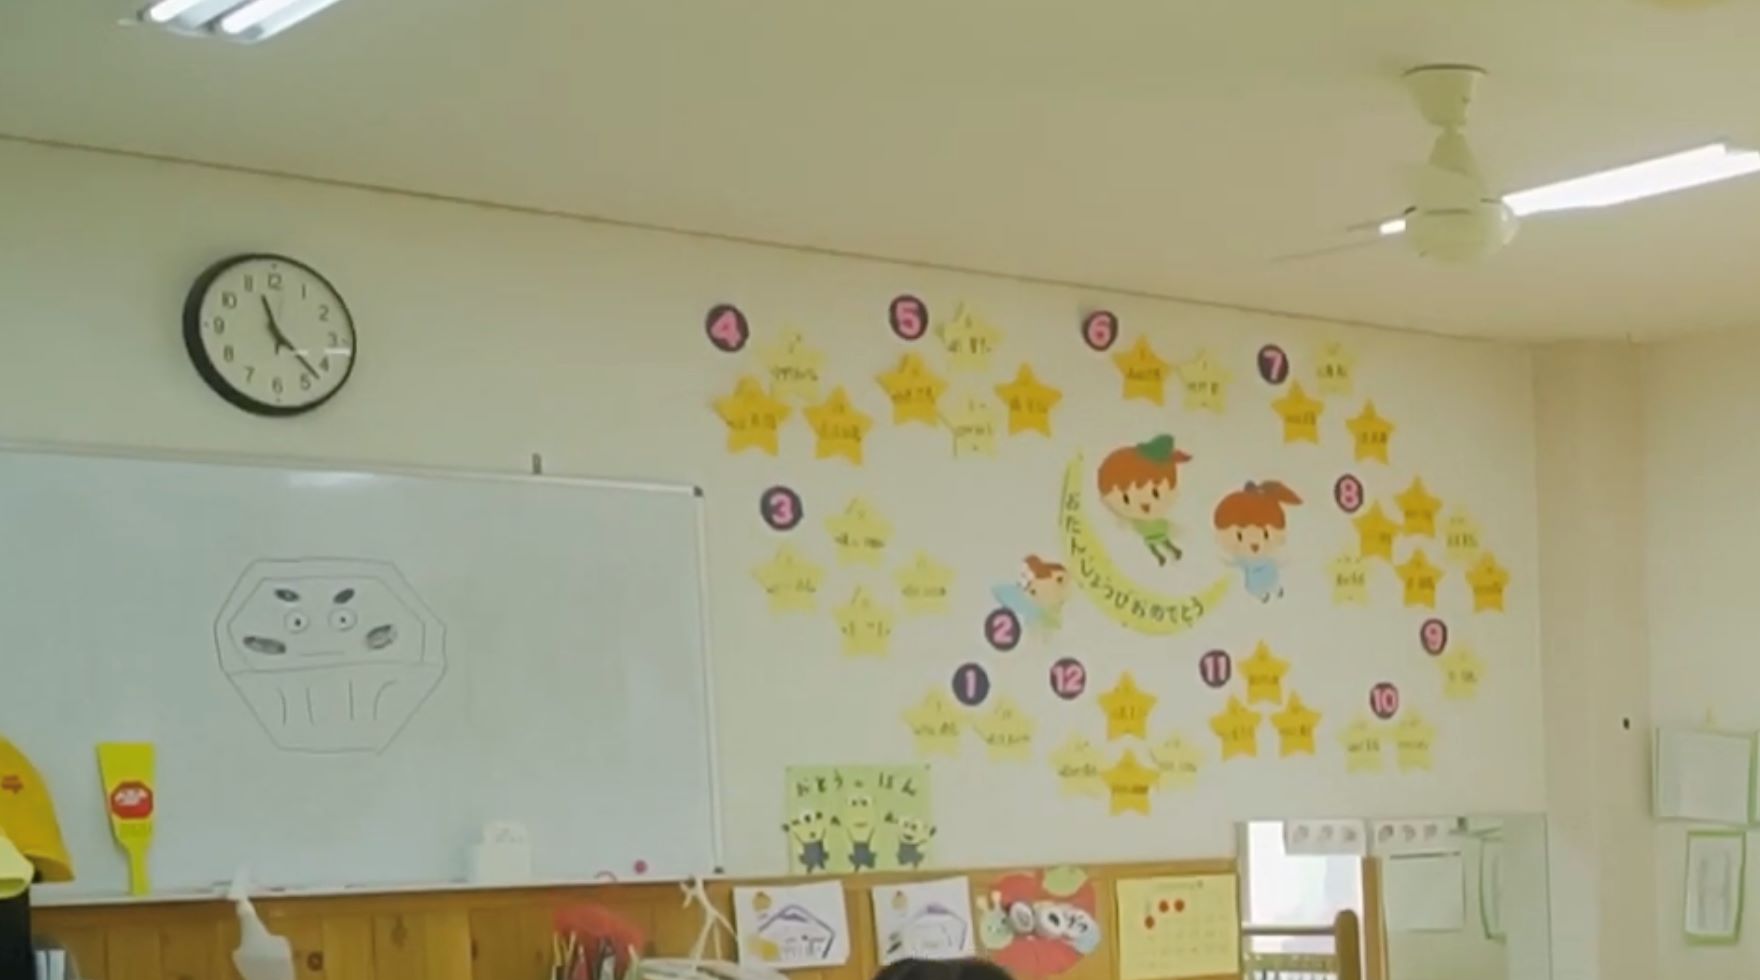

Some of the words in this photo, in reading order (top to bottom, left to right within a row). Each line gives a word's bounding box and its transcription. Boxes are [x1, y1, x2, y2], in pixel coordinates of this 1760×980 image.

[243, 276, 253, 291] 11
[268, 274, 281, 290] 12
[222, 292, 237, 308] 10
[319, 306, 329, 321] 2
[896, 301, 921, 336] 5
[214, 318, 224, 334] 9
[711, 311, 741, 348] 4
[1088, 314, 1111, 347] 6
[328, 332, 338, 347] 3
[224, 345, 234, 361] 8
[245, 367, 255, 382] 7
[319, 357, 329, 371] 4
[1264, 349, 1282, 380] 7
[272, 378, 283, 393] 6
[300, 376, 311, 390] 5
[1339, 478, 1360, 509] 8
[769, 492, 794, 525] 3
[992, 614, 1014, 644] 2
[1424, 622, 1443, 652] 9
[1052, 665, 1083, 692] 12
[1203, 653, 1229, 684] 11
[1373, 685, 1397, 716] 10
